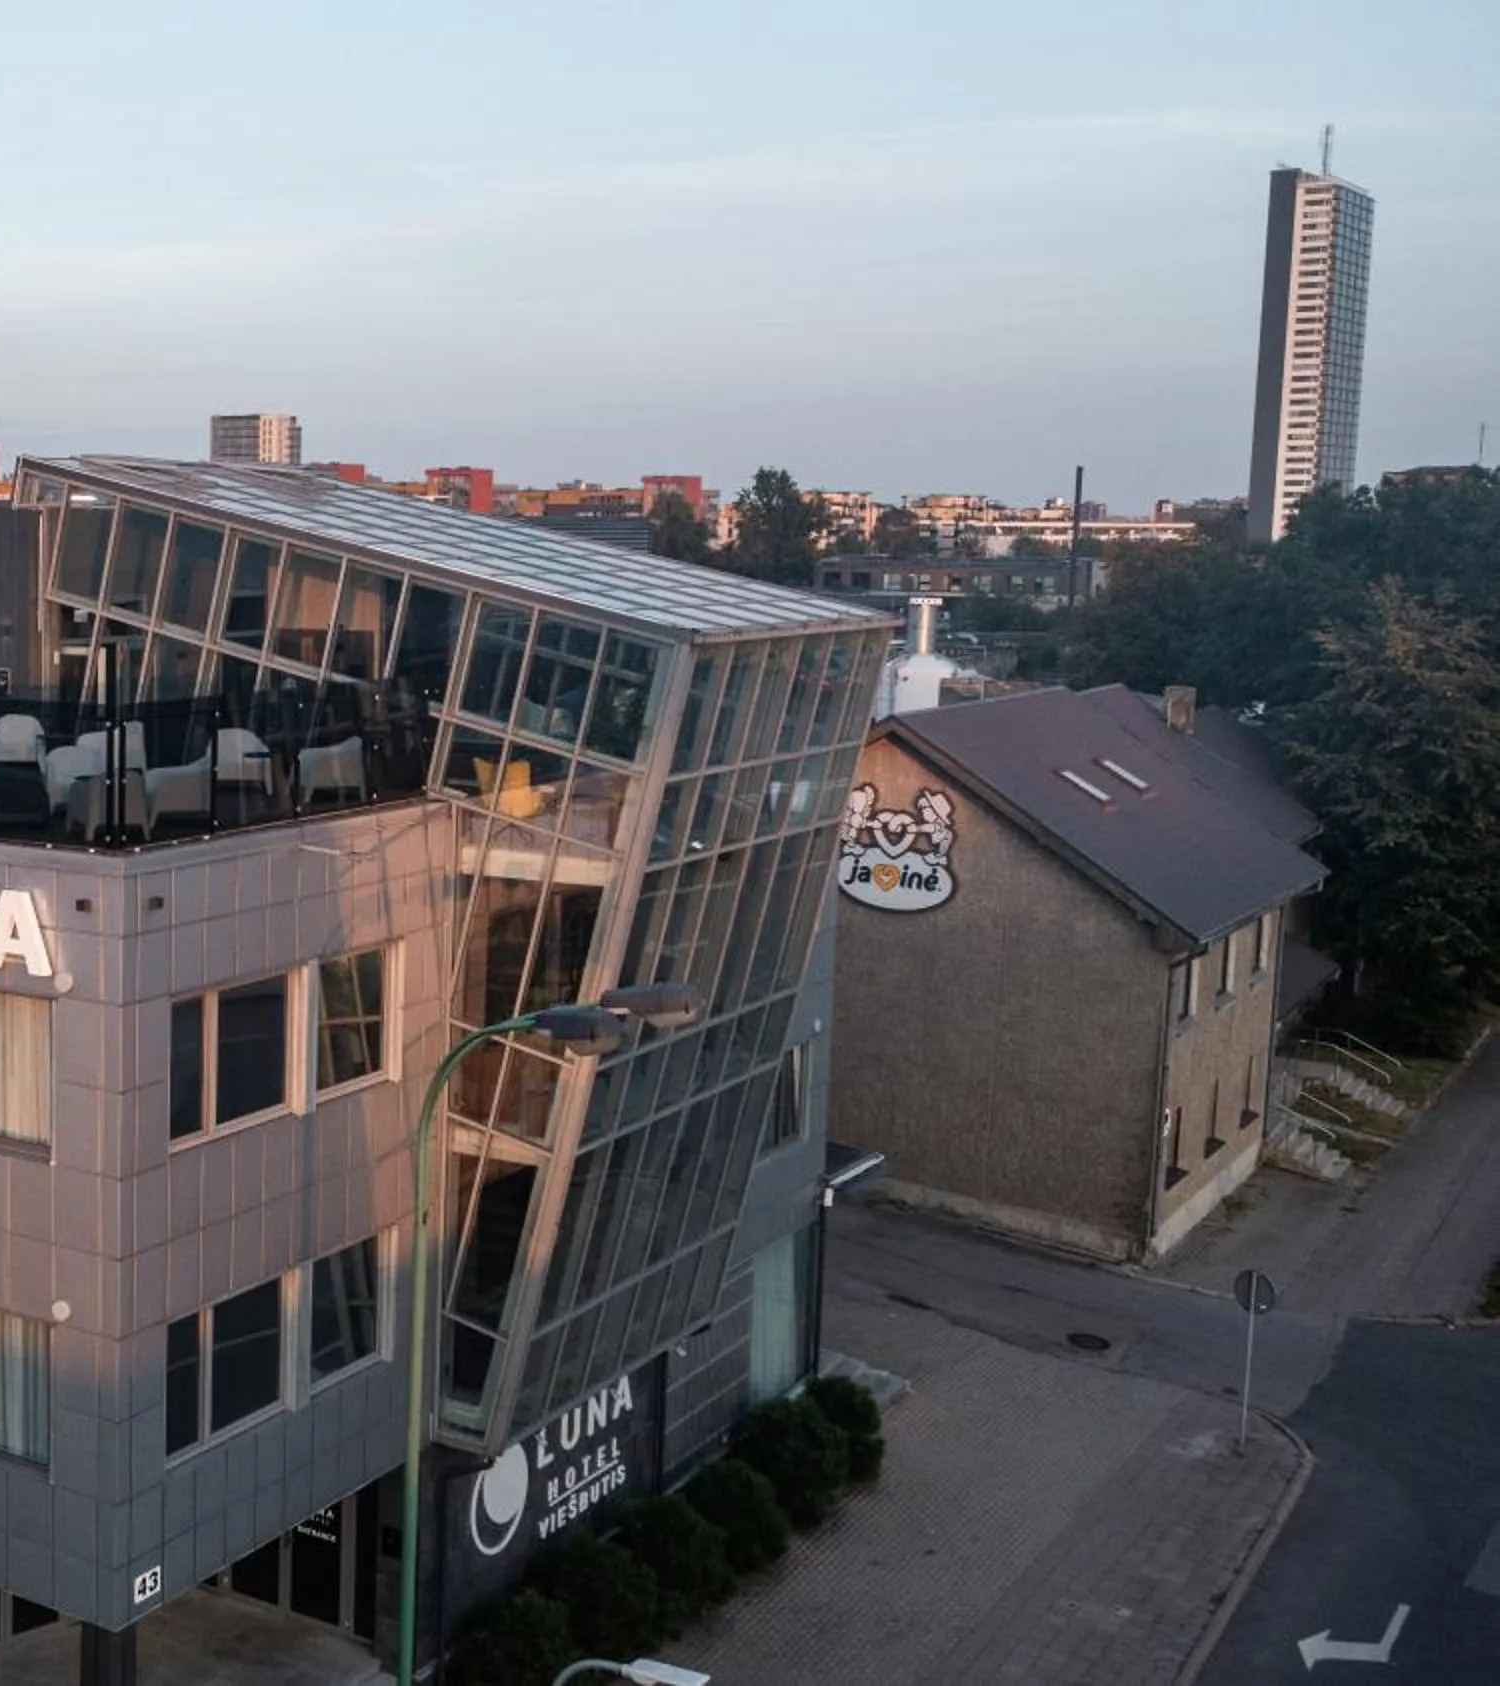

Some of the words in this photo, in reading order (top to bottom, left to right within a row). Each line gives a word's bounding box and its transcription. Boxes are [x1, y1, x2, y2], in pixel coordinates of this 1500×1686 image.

[536, 1374, 634, 1470] LUNA
[538, 1464, 627, 1540] VIEŠBUTIS
[547, 1436, 621, 1503] HOTEL
[137, 1571, 159, 1596] 43
